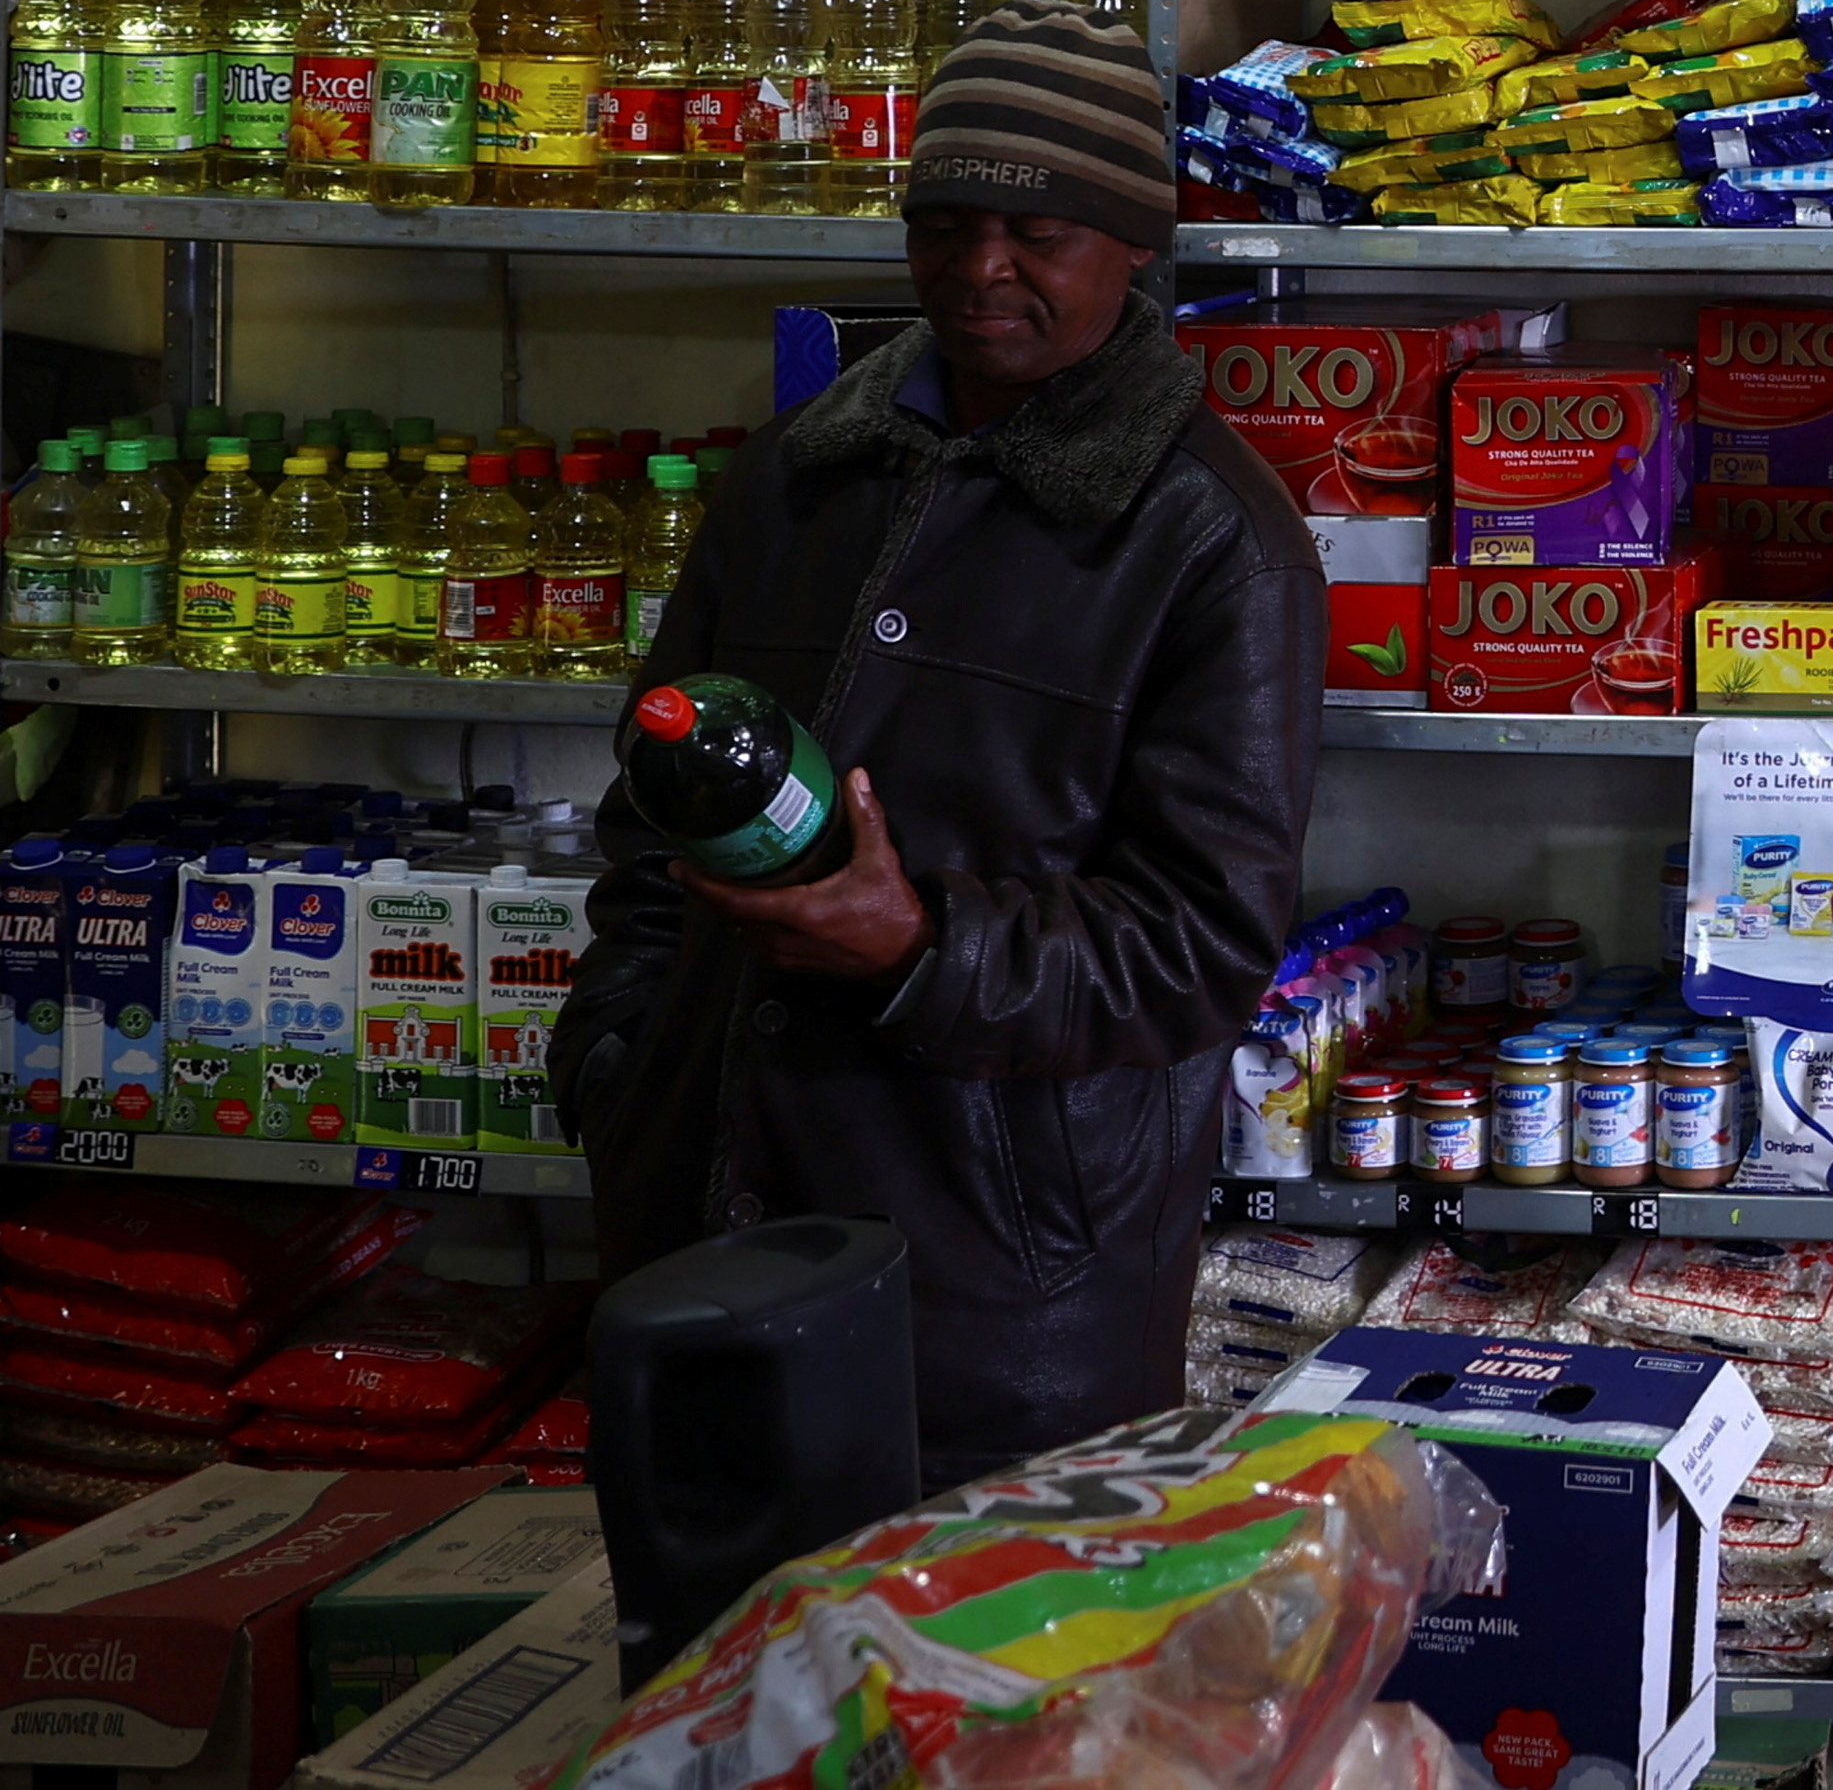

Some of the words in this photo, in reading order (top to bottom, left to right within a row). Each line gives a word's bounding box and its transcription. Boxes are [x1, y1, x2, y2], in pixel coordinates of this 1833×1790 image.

[1461, 396, 1623, 445] JOKO
[1488, 450, 1528, 459] STRONG
[1531, 450, 1573, 459] QUALITY
[1576, 449, 1594, 457] TEA
[543, 583, 605, 605] Excella
[1439, 580, 1619, 637] JOKO
[1722, 752, 1748, 766] It's
[1755, 753, 1783, 766] the
[1734, 774, 1752, 788] of
[1758, 777, 1767, 788] a
[376, 901, 443, 919] Bonnita
[78, 917, 147, 947] ULTRA
[279, 918, 335, 937] Clover
[177, 961, 199, 974] Full
[202, 962, 238, 976] Cream
[370, 944, 464, 981] milk
[1580, 1088, 1628, 1102] PURITY
[1765, 1141, 1814, 1157] Original
[417, 1157, 476, 1190] 1700
[1435, 1198, 1461, 1226] 14
[1464, 1360, 1563, 1381] ULTRA
[1575, 1472, 1621, 1485] 6202901
[11, 1711, 98, 1737] SUNFLOWER
[1498, 1735, 1521, 1744] NEW
[1524, 1737, 1554, 1748] PACK,
